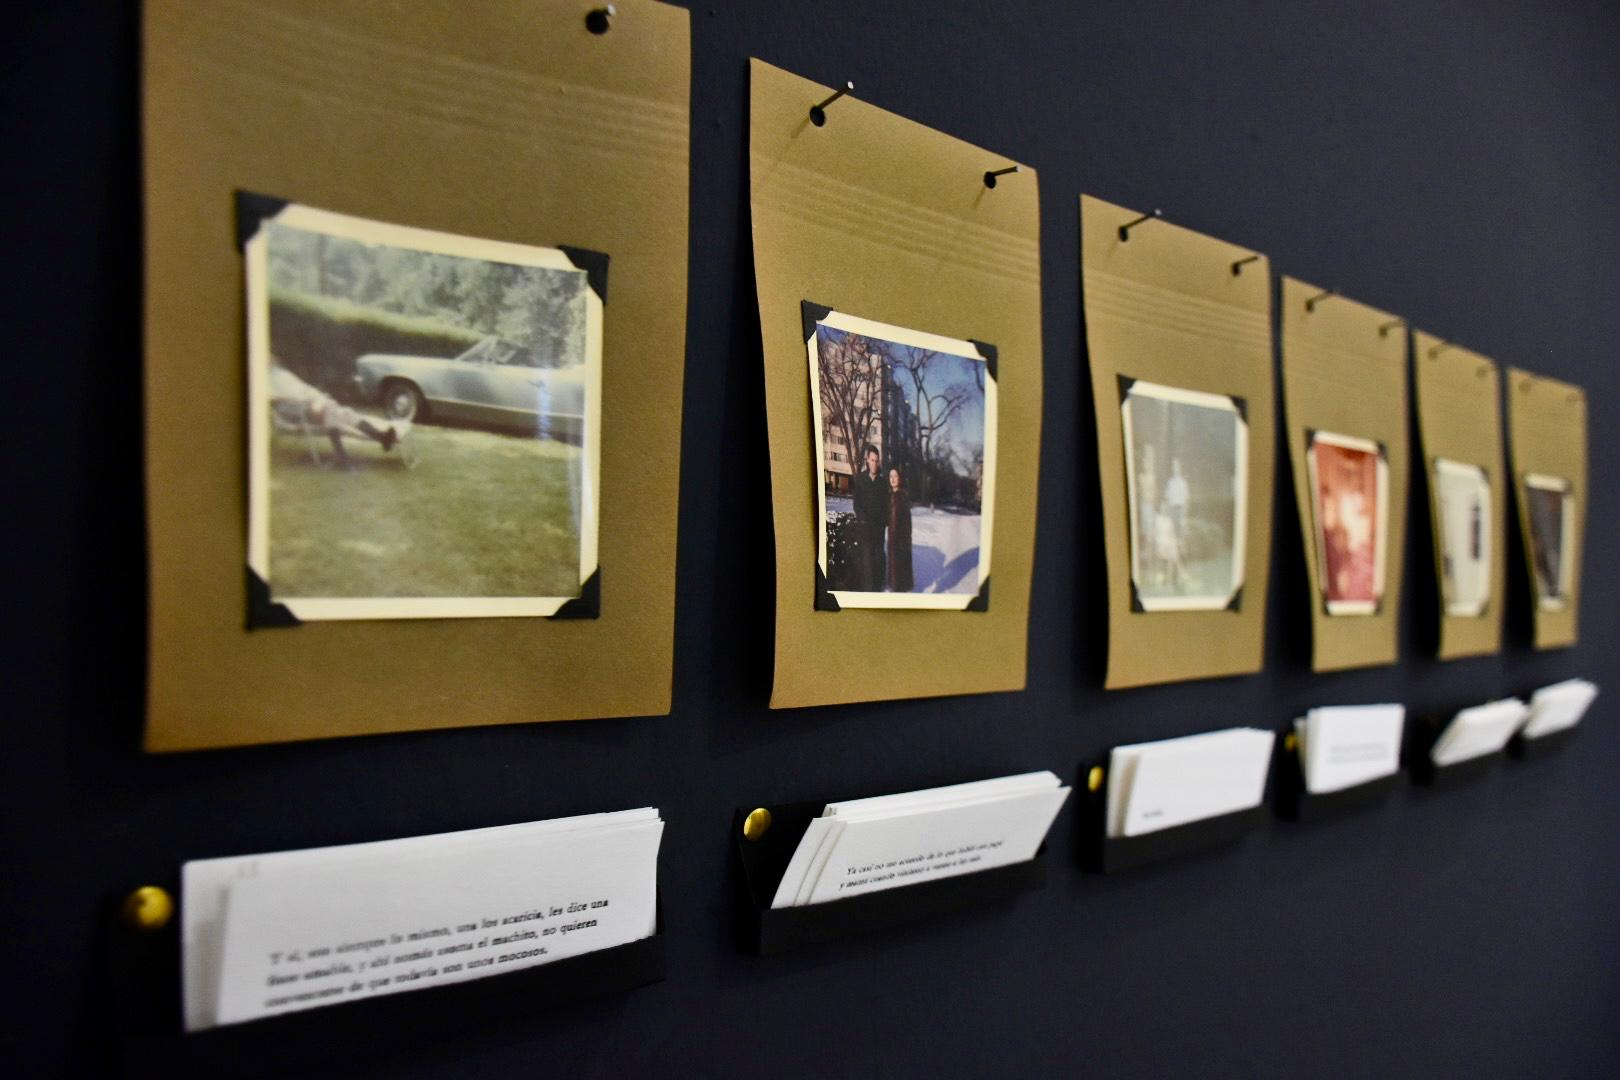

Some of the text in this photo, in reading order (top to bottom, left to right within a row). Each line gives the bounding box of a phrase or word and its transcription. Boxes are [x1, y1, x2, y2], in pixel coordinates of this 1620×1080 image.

[501, 908, 544, 926] acaricia,
[548, 905, 564, 918] les
[566, 902, 588, 914] dice
[590, 899, 609, 909] una
[541, 926, 558, 937] no
[560, 919, 598, 935] quieren
[498, 946, 548, 963] mocosos.
